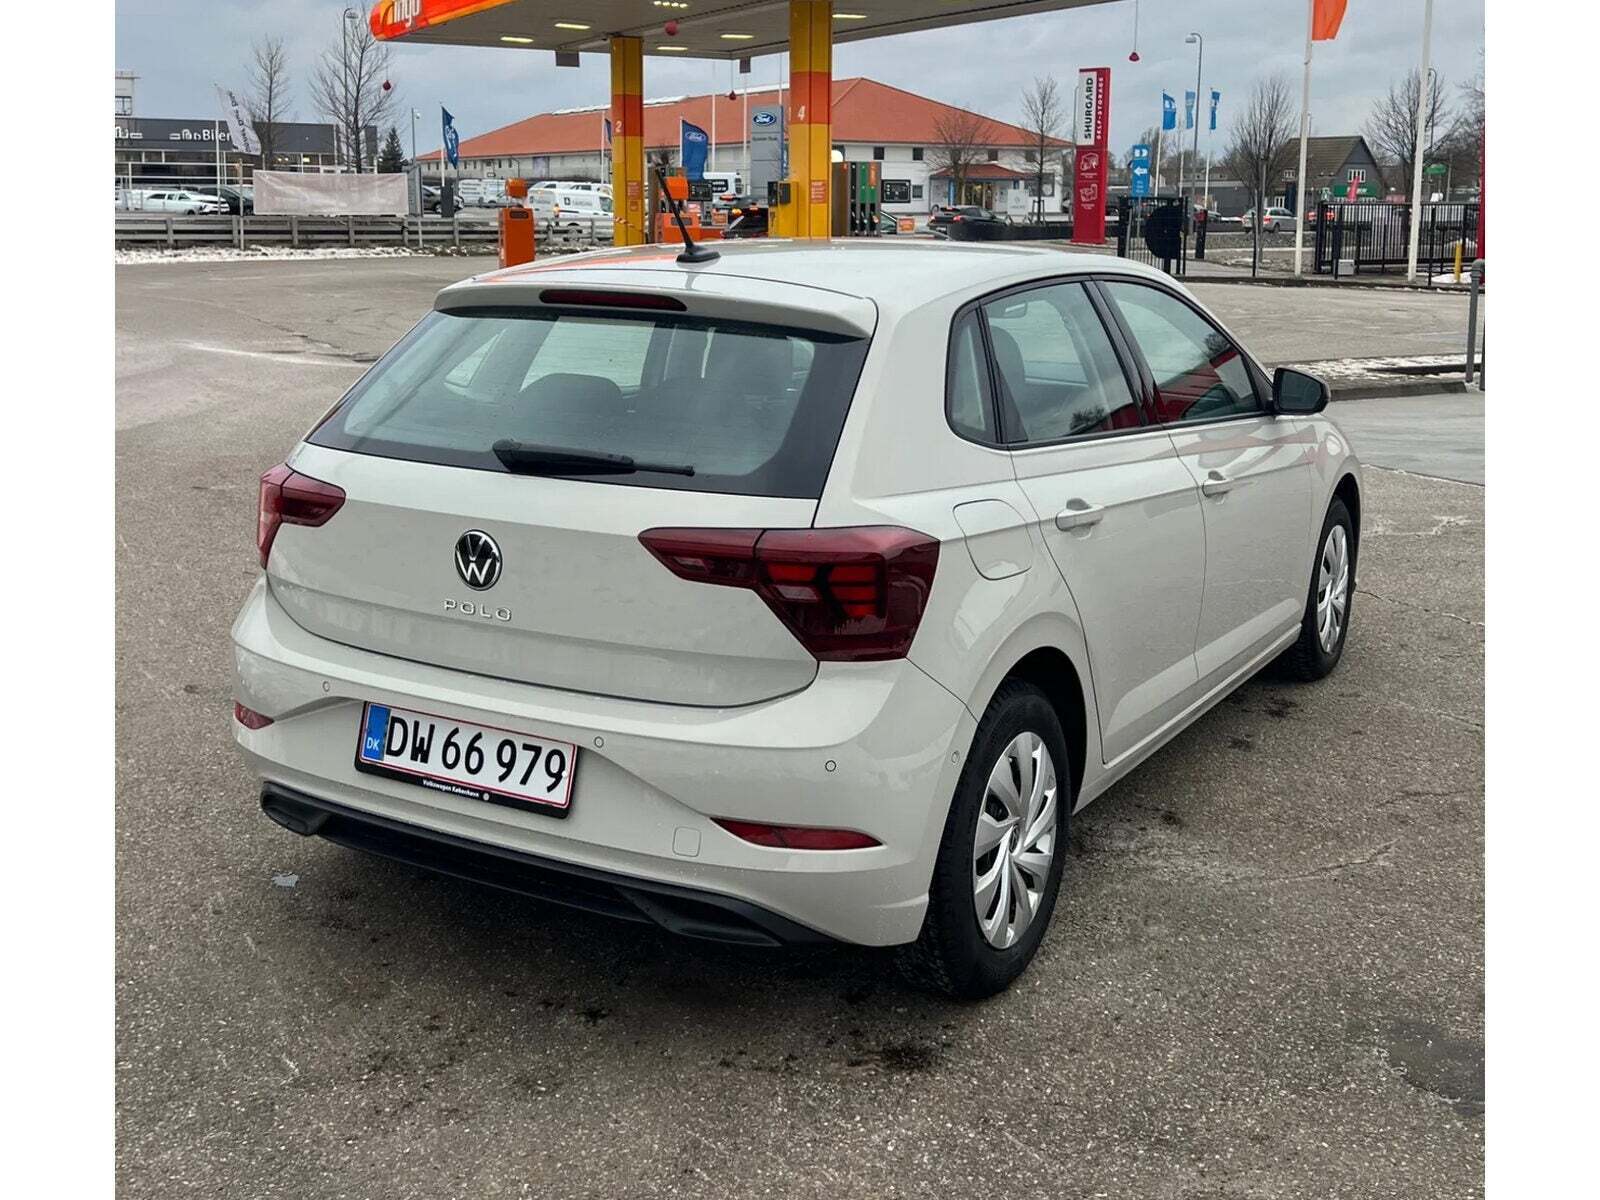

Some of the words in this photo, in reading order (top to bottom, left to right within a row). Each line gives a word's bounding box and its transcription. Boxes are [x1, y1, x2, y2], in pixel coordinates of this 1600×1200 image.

[798, 106, 805, 120] 4
[1084, 77, 1093, 139] SHURGARD
[1096, 77, 1104, 140] SELF-STORAGE
[755, 113, 775, 125] Ford
[616, 121, 622, 133] 2
[444, 599, 511, 621] POLO
[367, 737, 380, 751] DK
[386, 716, 435, 764] DW
[442, 727, 484, 775] 66
[496, 739, 566, 793] 979
[423, 779, 452, 791] Volkswagen
